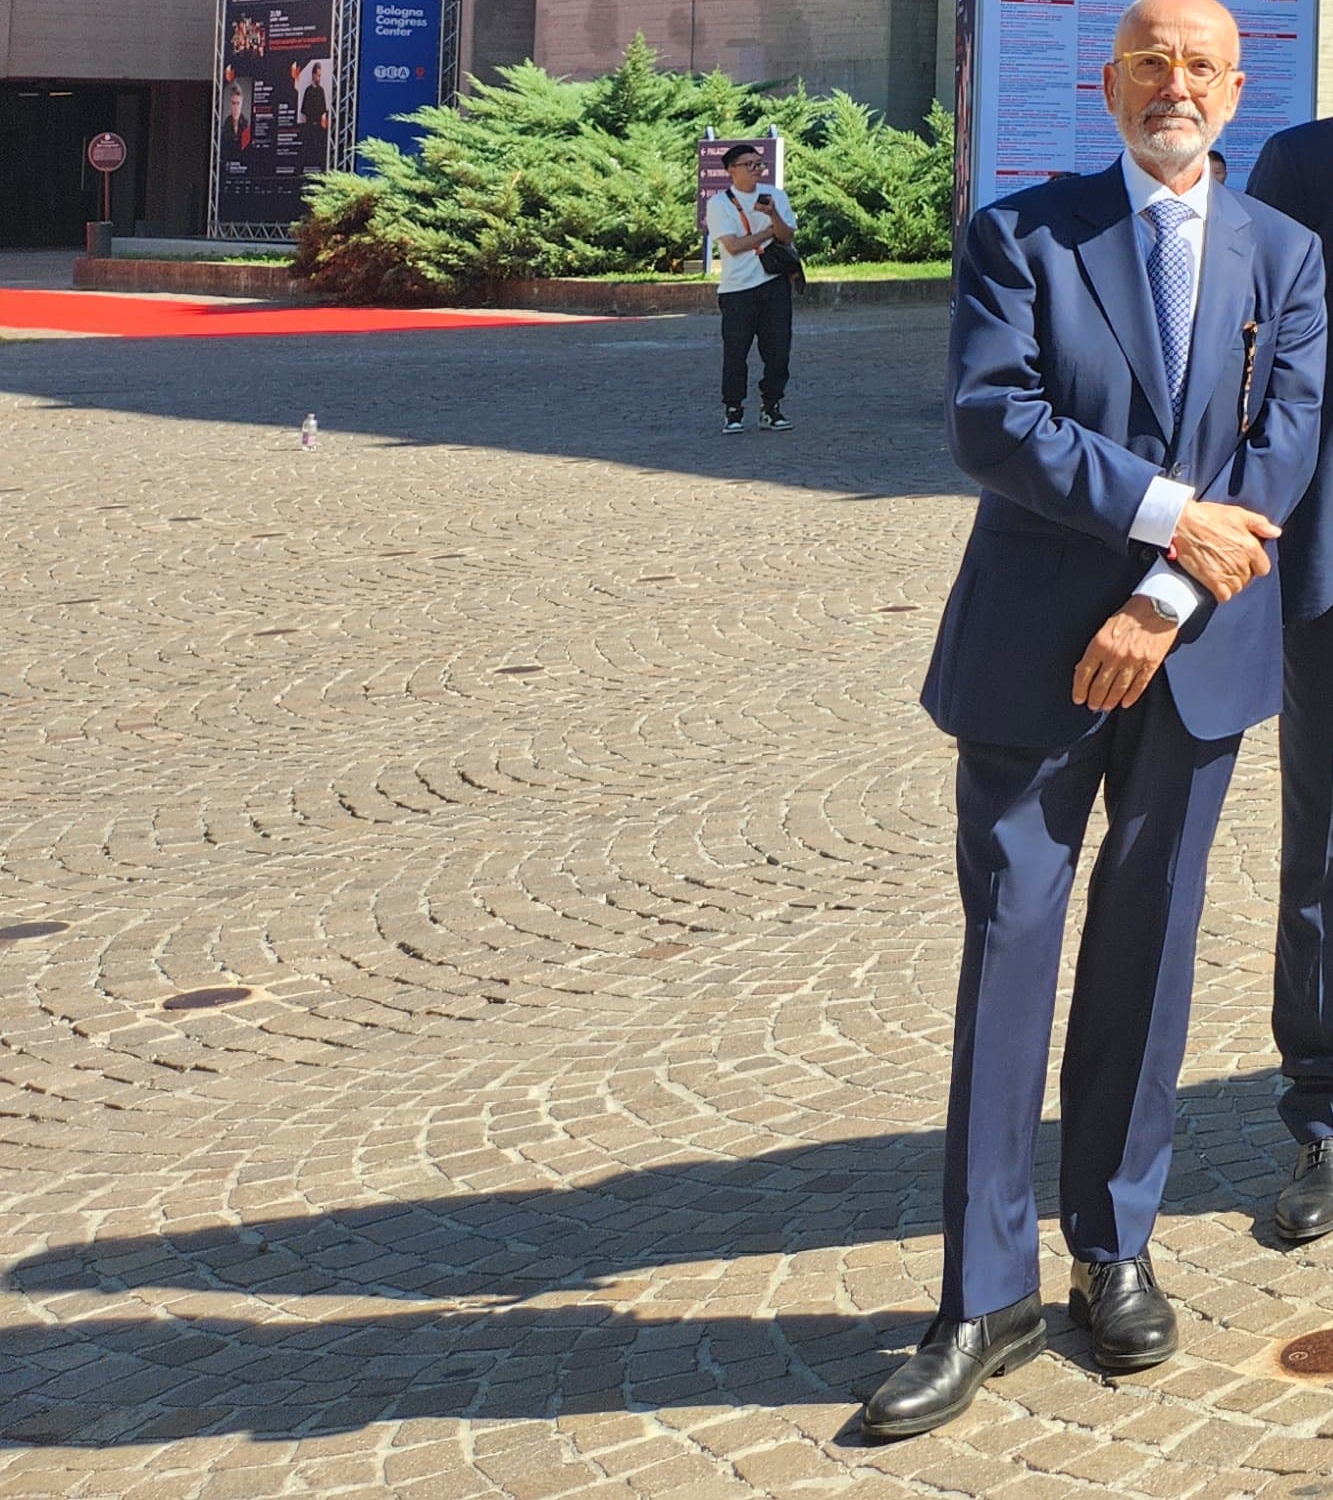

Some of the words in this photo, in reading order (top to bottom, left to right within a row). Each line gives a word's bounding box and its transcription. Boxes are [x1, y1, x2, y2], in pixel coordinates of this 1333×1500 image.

[375, 4, 424, 18] Bologna
[375, 15, 428, 28] Congress
[375, 25, 413, 37] Center
